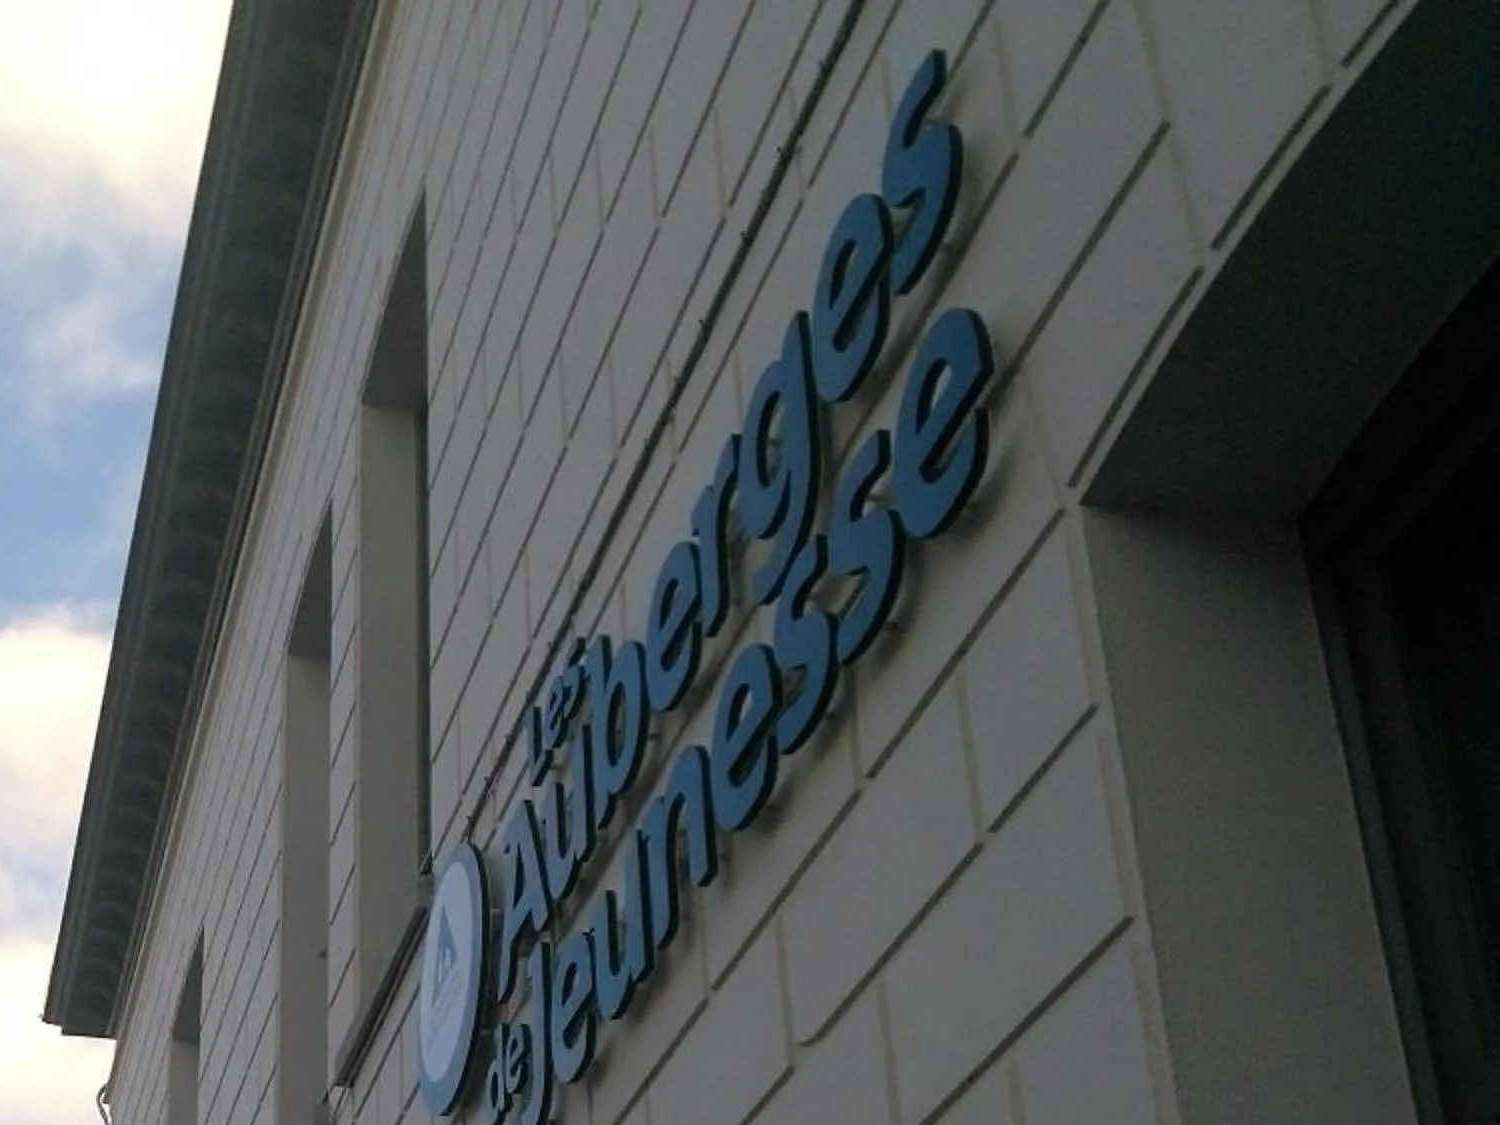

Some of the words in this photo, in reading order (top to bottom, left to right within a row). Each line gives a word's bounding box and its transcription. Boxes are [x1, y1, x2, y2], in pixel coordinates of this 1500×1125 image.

[498, 49, 963, 1004] Auberges
[520, 637, 587, 786] Les
[485, 1021, 532, 1125] de
